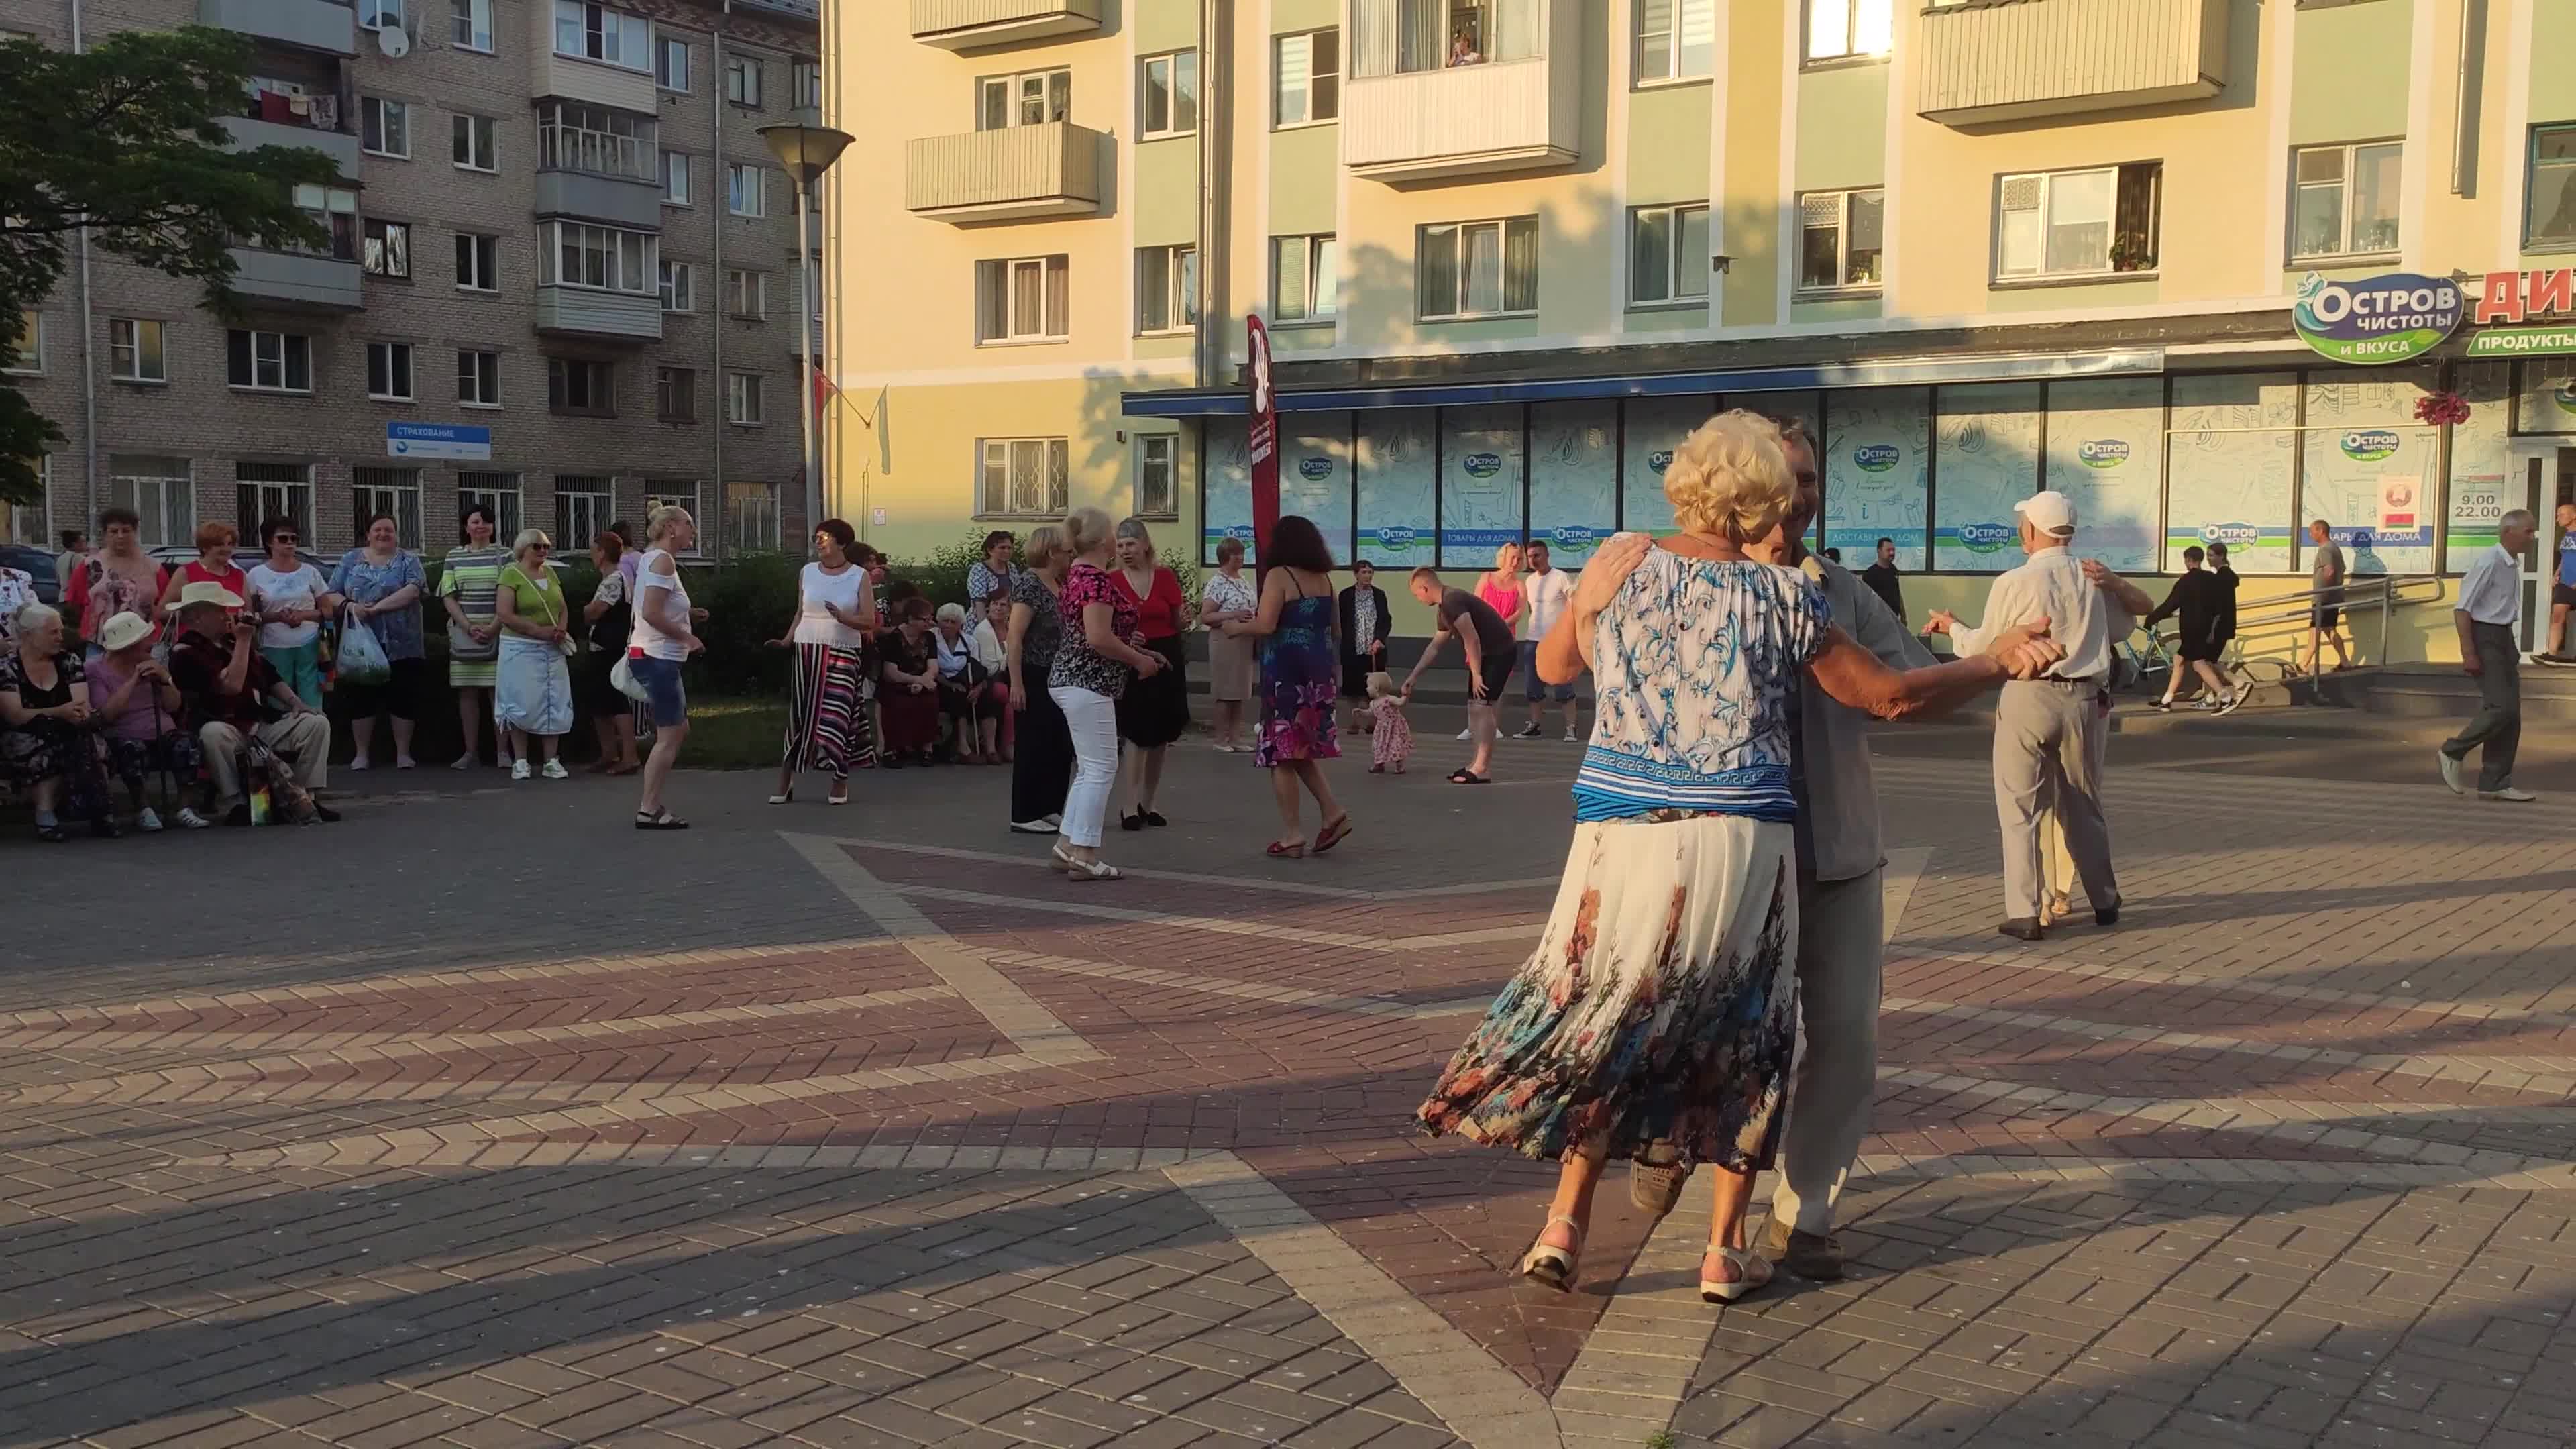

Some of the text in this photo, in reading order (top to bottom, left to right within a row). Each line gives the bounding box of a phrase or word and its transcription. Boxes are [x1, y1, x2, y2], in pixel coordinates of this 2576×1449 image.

[2312, 286, 2456, 323] ОСТРОВ
[2357, 313, 2453, 331] ЧИСТОТЫ
[2341, 341, 2410, 355] И ВКУСА
[2478, 334, 2576, 350] ПРОДУКТЫ
[397, 427, 455, 437] СТРАХОВАНИЕ
[2347, 434, 2398, 447] ОСТРОВ
[2462, 495, 2495, 505] 9.00
[2455, 506, 2500, 517] 22.00
[1228, 527, 1253, 537] ОСТРО
[1965, 526, 2009, 539] ОСТРОВ
[2205, 526, 2256, 539] ОСТРОВ
[2359, 532, 2381, 541] ДЛЯ
[2383, 532, 2421, 541] ДОМА
